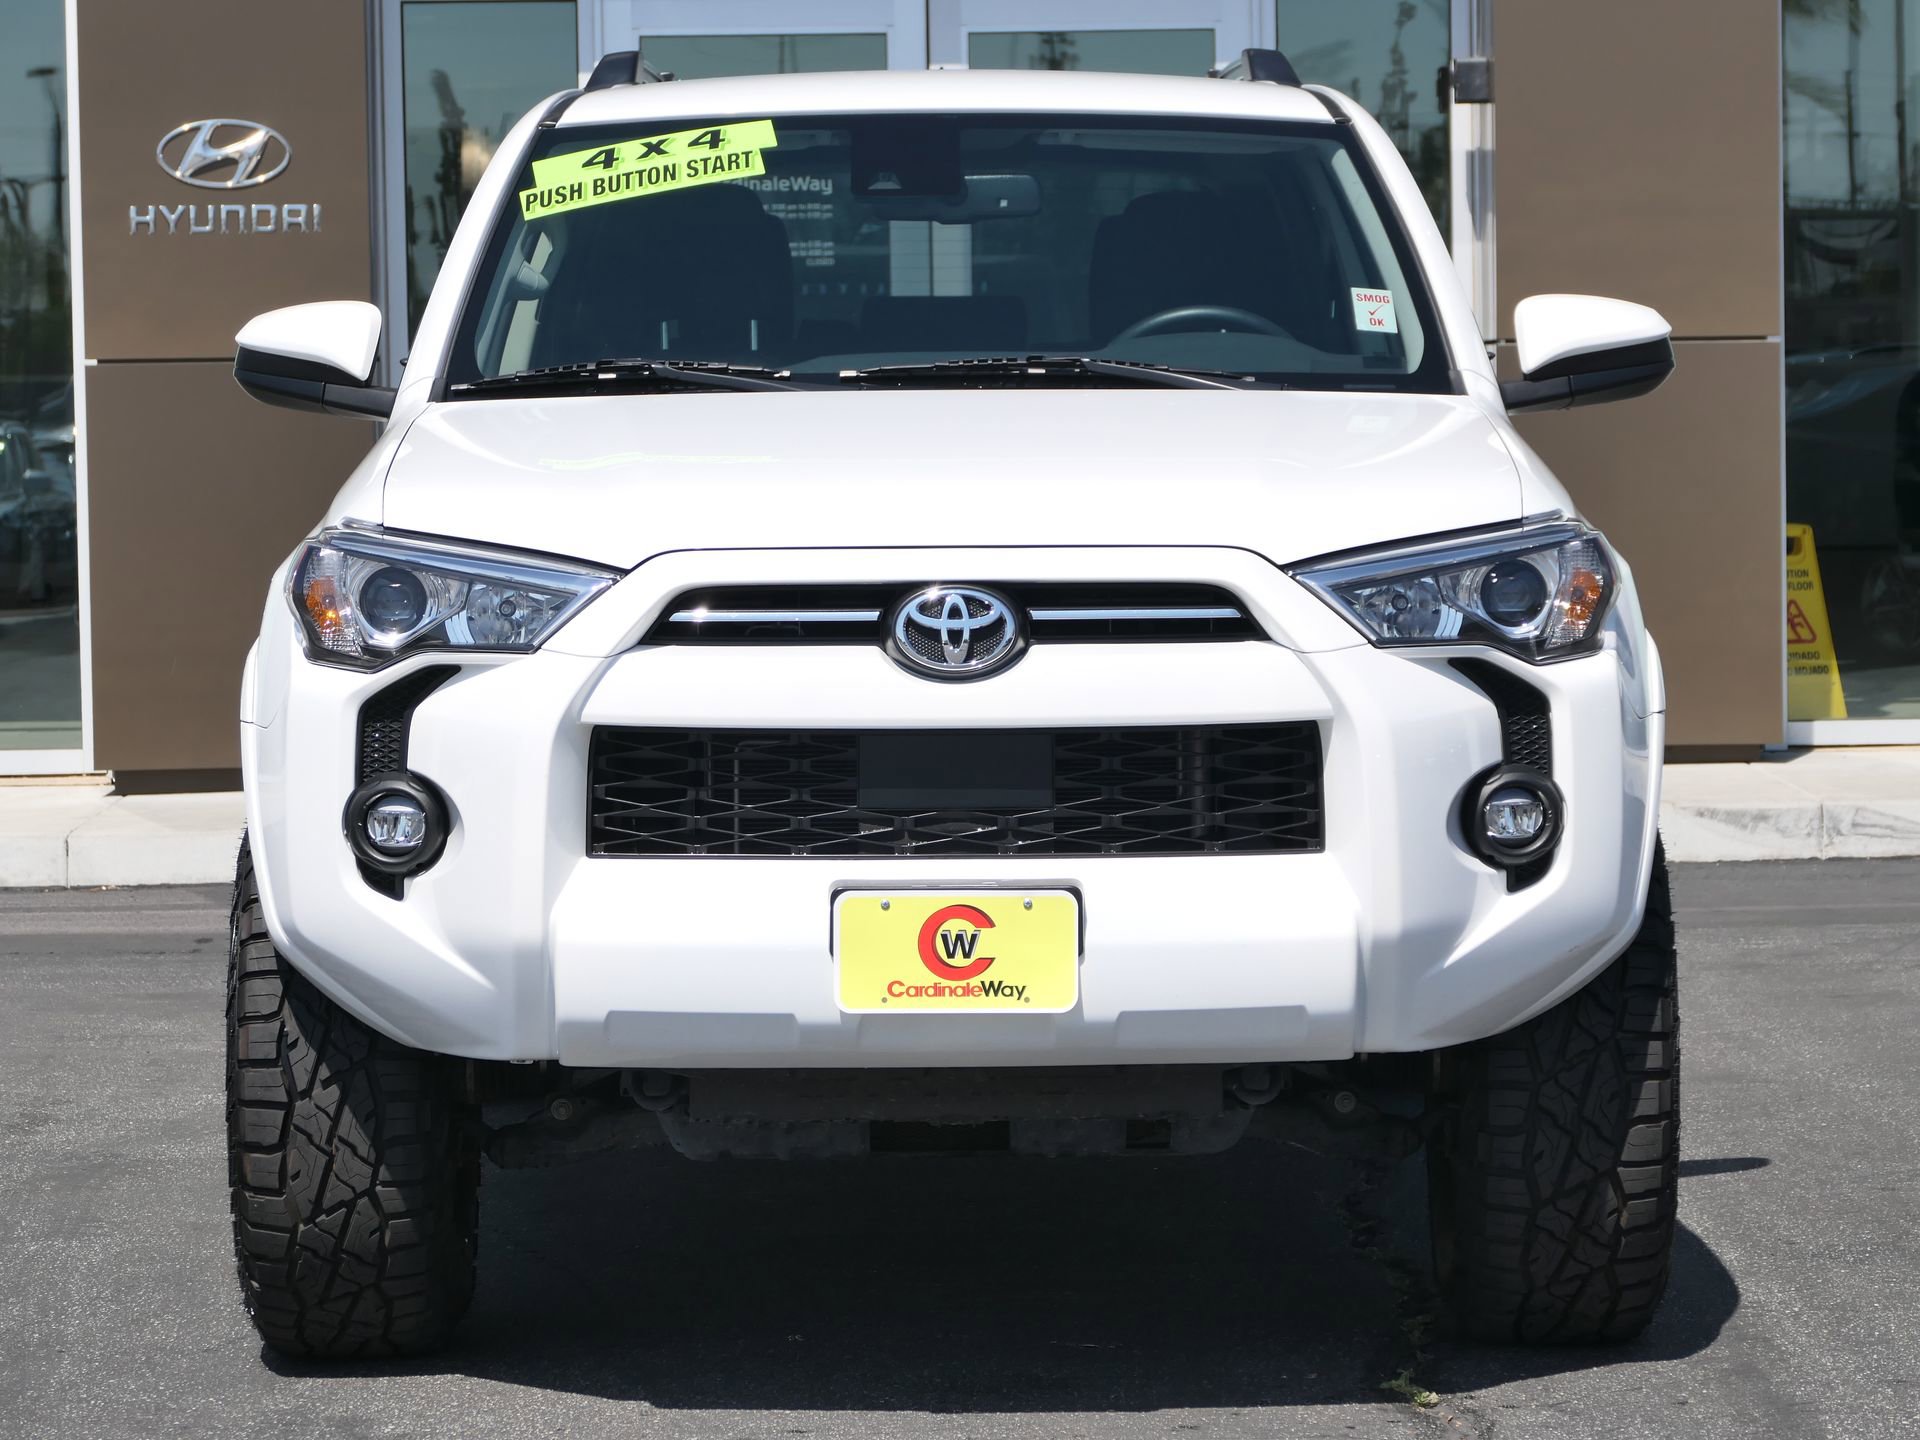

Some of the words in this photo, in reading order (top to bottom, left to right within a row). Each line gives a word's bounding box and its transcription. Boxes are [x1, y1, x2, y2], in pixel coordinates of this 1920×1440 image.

[581, 147, 620, 170] 4
[687, 128, 726, 150] 4
[525, 182, 583, 212] PUSH
[593, 163, 677, 197] BUTTON
[686, 150, 753, 178] START
[722, 175, 833, 195] dinaleWay
[129, 203, 321, 235] HYUNDAI
[1356, 293, 1390, 304] SMOG
[1369, 317, 1385, 327] OK
[1787, 568, 1809, 579] TION
[887, 980, 1026, 1001] CardinaleWay
